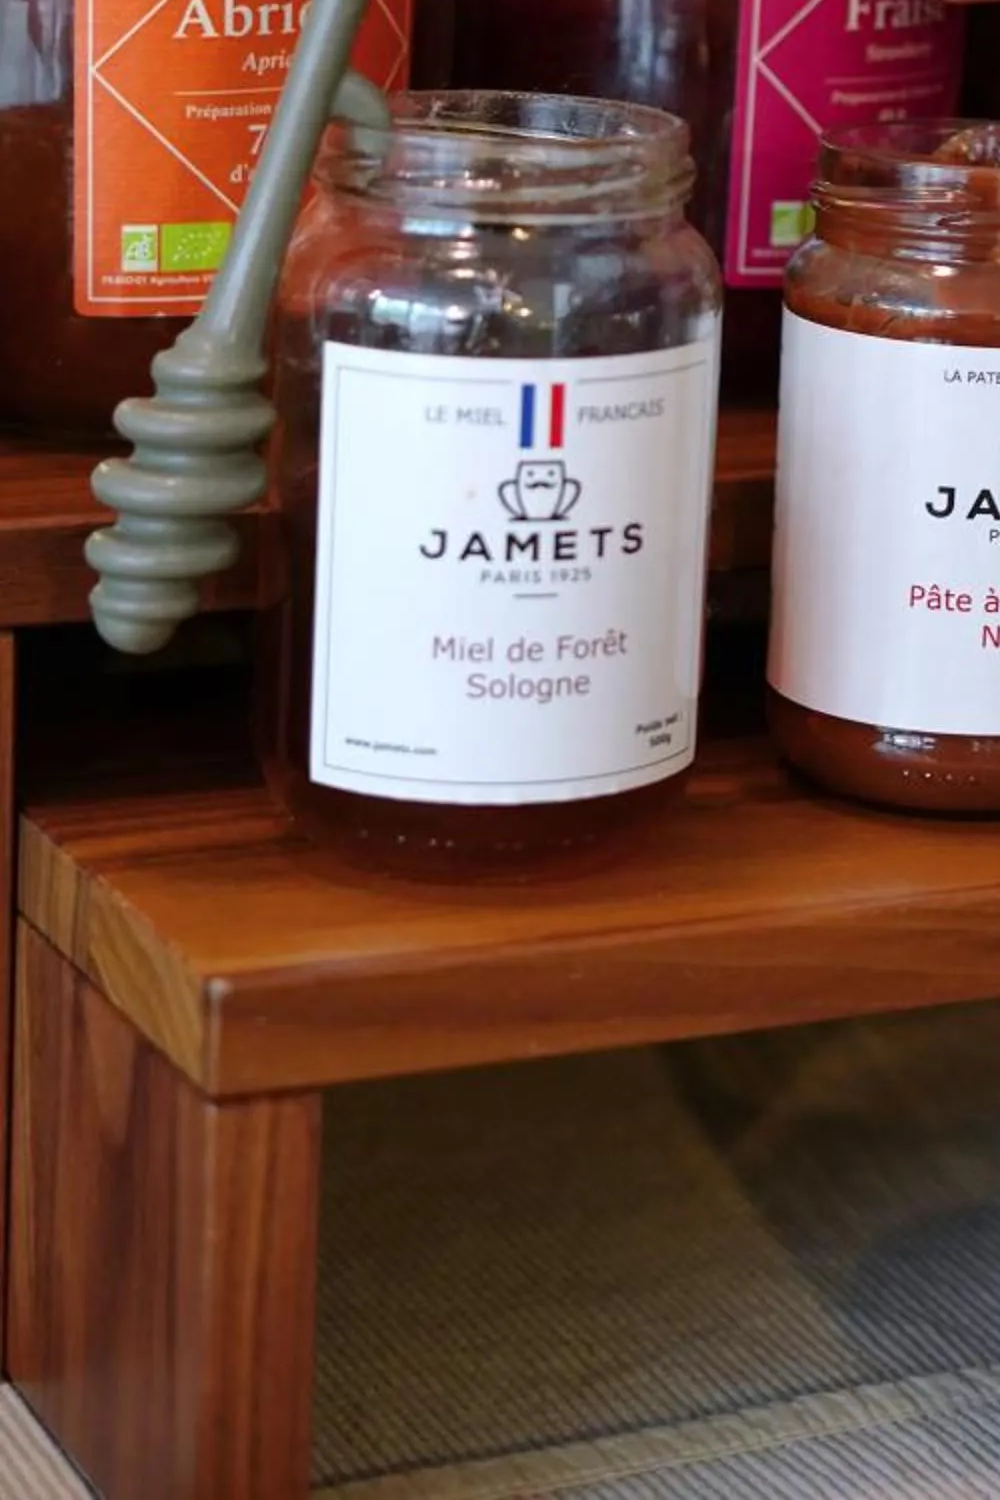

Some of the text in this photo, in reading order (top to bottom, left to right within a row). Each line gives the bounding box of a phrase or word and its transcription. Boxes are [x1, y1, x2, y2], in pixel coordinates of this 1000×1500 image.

[248, 123, 270, 155] 7
[942, 369, 962, 383] LA
[424, 398, 665, 426] LE MIEL FRANCAIS
[419, 523, 645, 563] JAMETS
[480, 567, 593, 584] PARIS 1925
[908, 583, 973, 614] Pâte
[983, 585, 1000, 614] à
[431, 629, 628, 663] Miel de Forêt
[465, 671, 592, 704] Sologne
